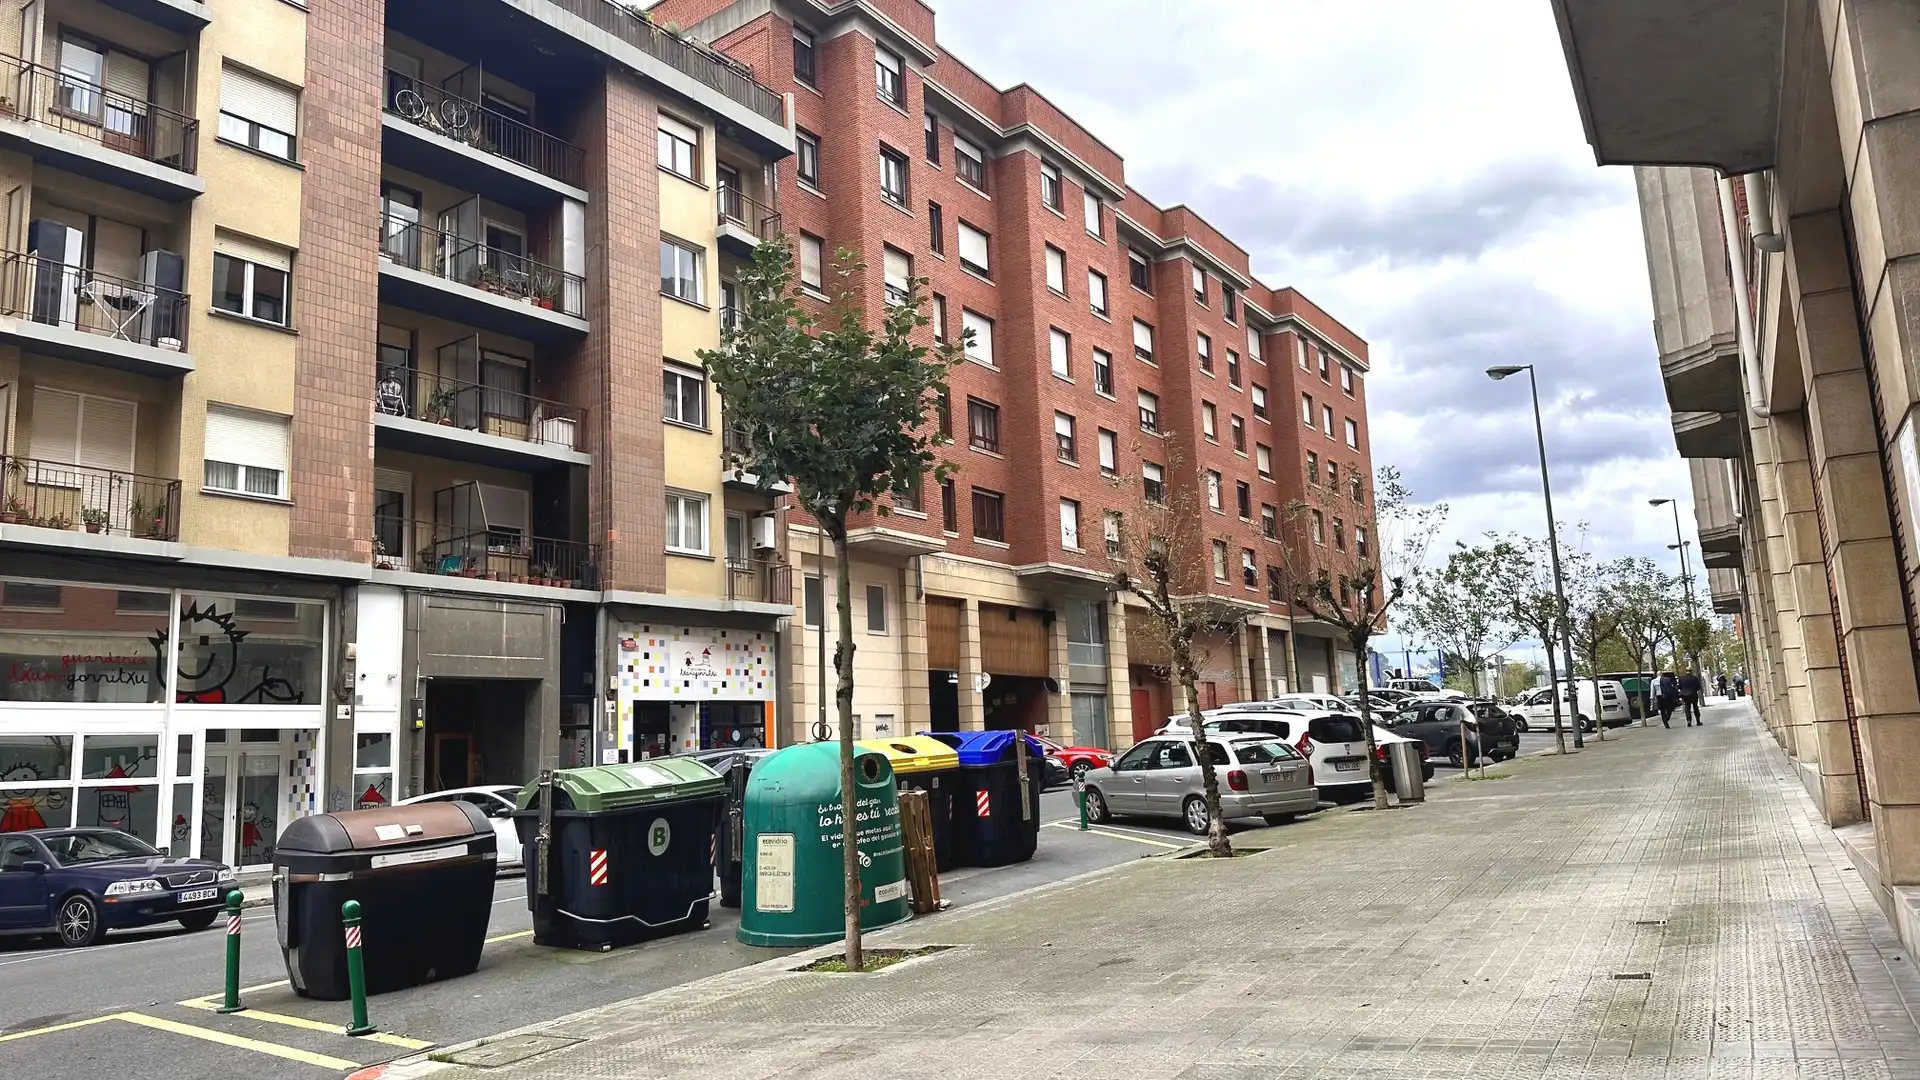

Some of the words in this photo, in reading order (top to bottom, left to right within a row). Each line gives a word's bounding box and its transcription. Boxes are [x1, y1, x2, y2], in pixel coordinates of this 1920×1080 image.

[62, 650, 147, 667] guardería
[856, 798, 869, 807] del
[819, 816, 834, 827] lo
[870, 807, 881, 819] tú
[653, 827, 666, 847] B
[865, 827, 882, 835] metas
[183, 891, 202, 901] 4493
